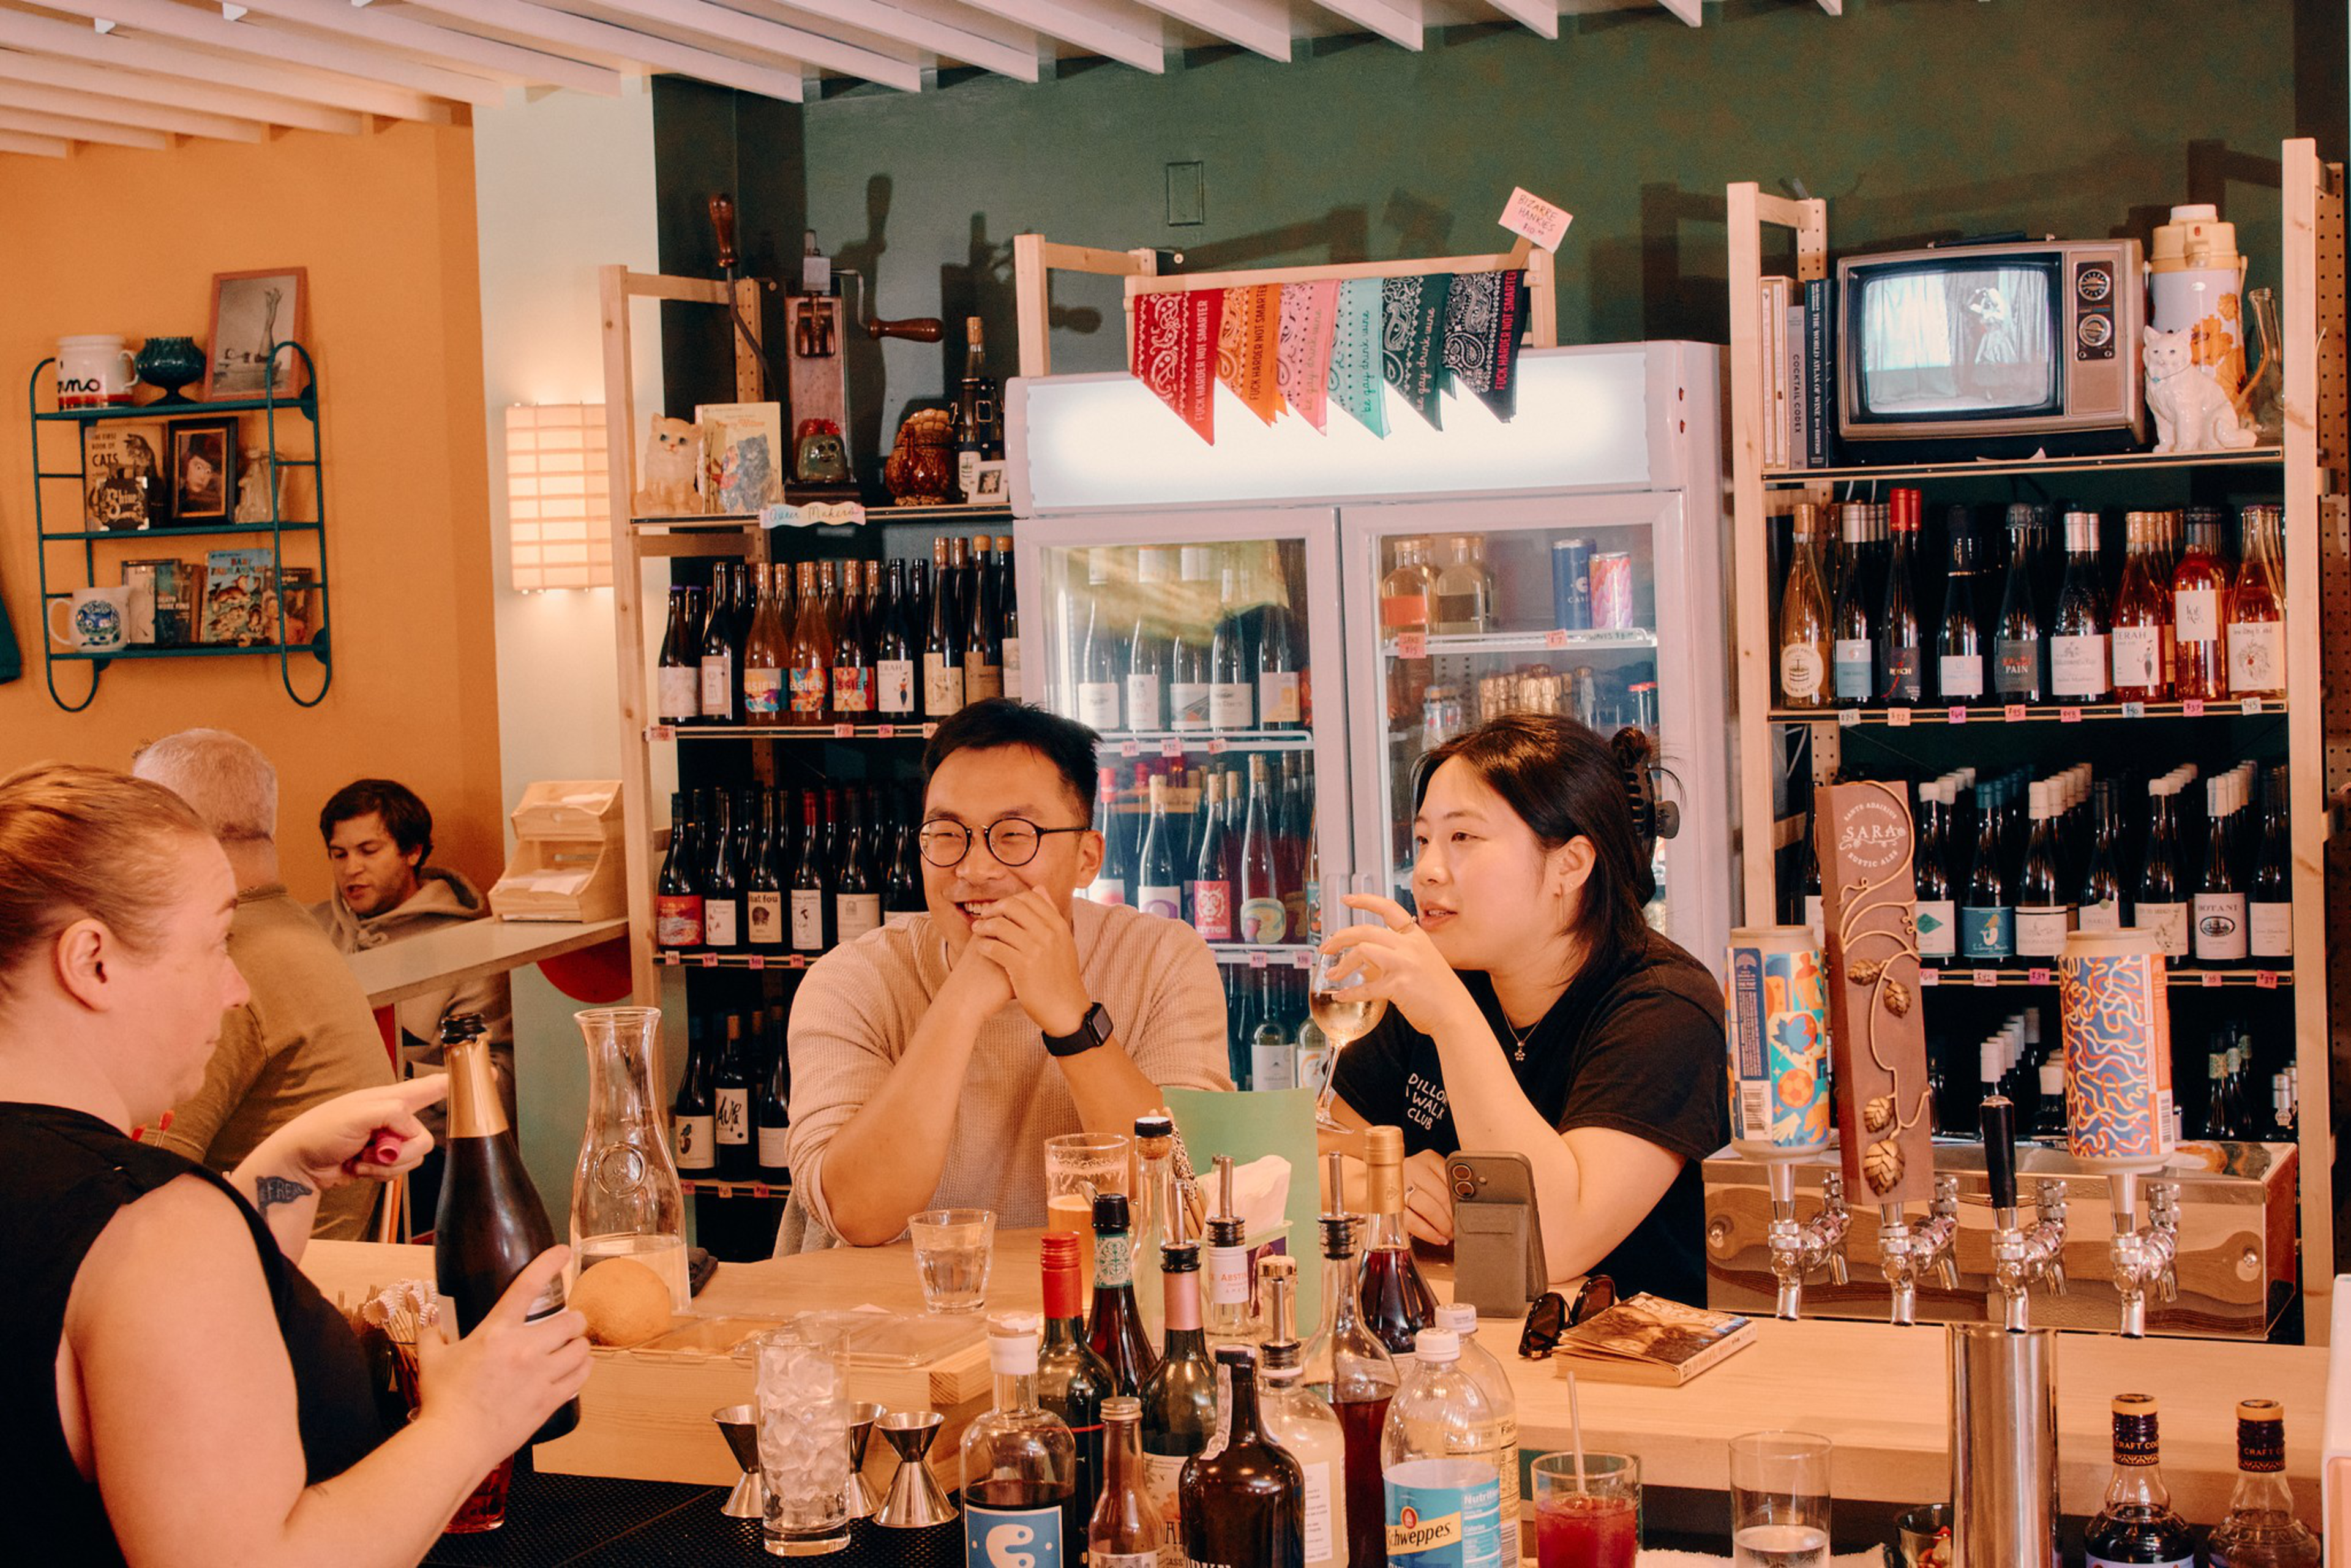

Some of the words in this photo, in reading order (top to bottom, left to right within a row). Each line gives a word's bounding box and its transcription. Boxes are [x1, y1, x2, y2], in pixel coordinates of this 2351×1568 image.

[1518, 194, 1558, 221] BIZARRE
[1518, 207, 1556, 231] HANKIES
[1504, 270, 1518, 312] SMARTER
[1196, 300, 1208, 342] SMARTER
[1425, 307, 1436, 334] wine
[1502, 313, 1513, 331] NOT
[1254, 326, 1265, 343] NOT
[1196, 343, 1207, 361] NOT
[1359, 339, 1369, 369] drink
[1416, 336, 1431, 367] drink
[1498, 332, 1511, 367] HARDER
[1251, 345, 1264, 377] HARDER
[1195, 362, 1207, 397] HARDER
[1249, 378, 1261, 400] FUCK
[1362, 372, 1376, 396] gay
[1418, 370, 1432, 395] gay
[1495, 368, 1507, 390] FUCK
[1813, 384, 1821, 394] OF
[1194, 397, 1206, 421] FUCK
[1362, 399, 1371, 413] be
[92, 453, 119, 467] CATS
[770, 508, 798, 521] Queer
[808, 506, 860, 519] Makers
[1589, 632, 1613, 641] WAVES
[2115, 631, 2147, 640] TERAH
[2243, 700, 2258, 709] $45
[1843, 803, 1864, 821] SANTE
[1865, 802, 1897, 820] ADAIRIUS
[1846, 823, 1897, 839] SARA
[1848, 852, 1878, 868] RUSTIC
[1881, 849, 1898, 866] ALES
[762, 895, 778, 904] fou
[1412, 1092, 1445, 1120] WALK
[1407, 1108, 1433, 1130] CLUB
[2115, 1440, 2141, 1450] CRAFT
[2244, 1447, 2273, 1456] CRAFT
